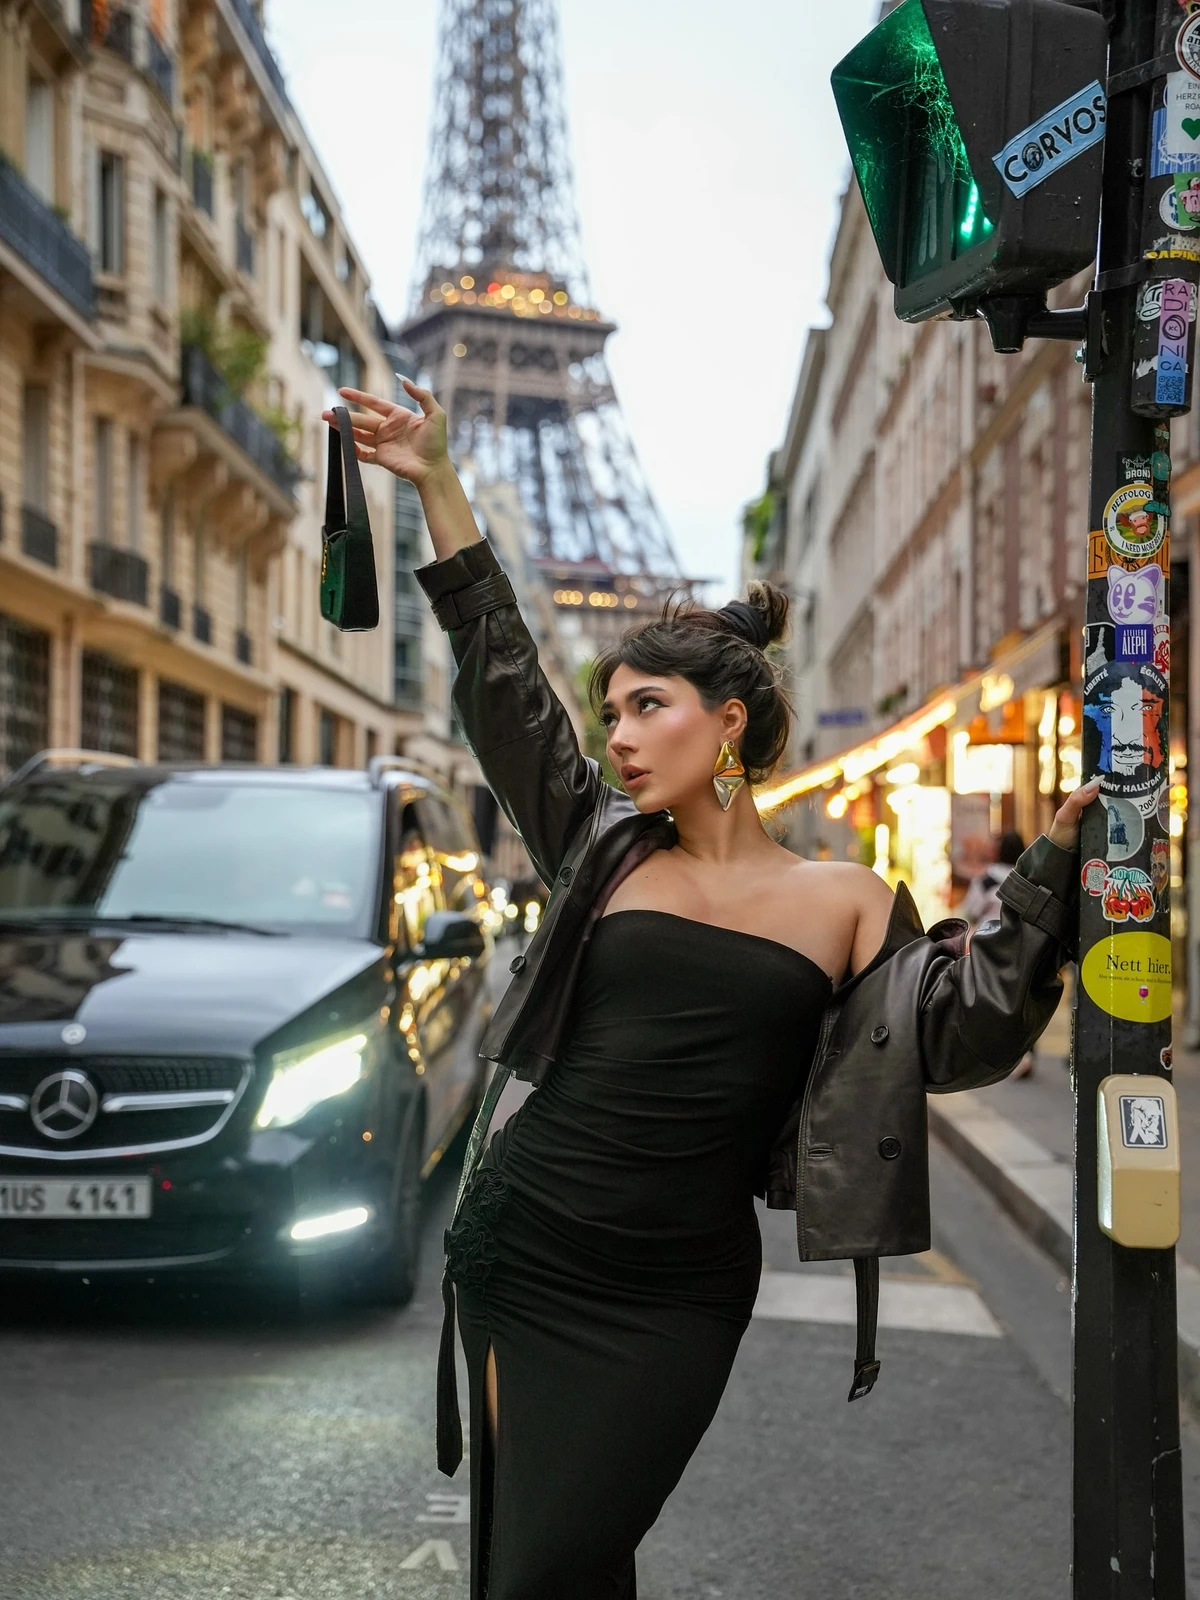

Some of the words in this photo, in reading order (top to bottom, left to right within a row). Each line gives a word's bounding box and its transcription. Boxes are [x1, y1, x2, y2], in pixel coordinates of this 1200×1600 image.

[1176, 93, 1199, 101] HERZ
[1125, 541, 1140, 553] NEED
[1122, 629, 1147, 655] ALEPH
[1083, 668, 1109, 696] LIBERTÉ
[1140, 665, 1166, 691] ÉGALITÉ
[1122, 772, 1161, 793] HALLYDAY
[1112, 869, 1126, 880] HOT
[1106, 954, 1142, 972] Nett
[1147, 957, 1171, 975] hier.
[66, 1185, 136, 1212] 4141
